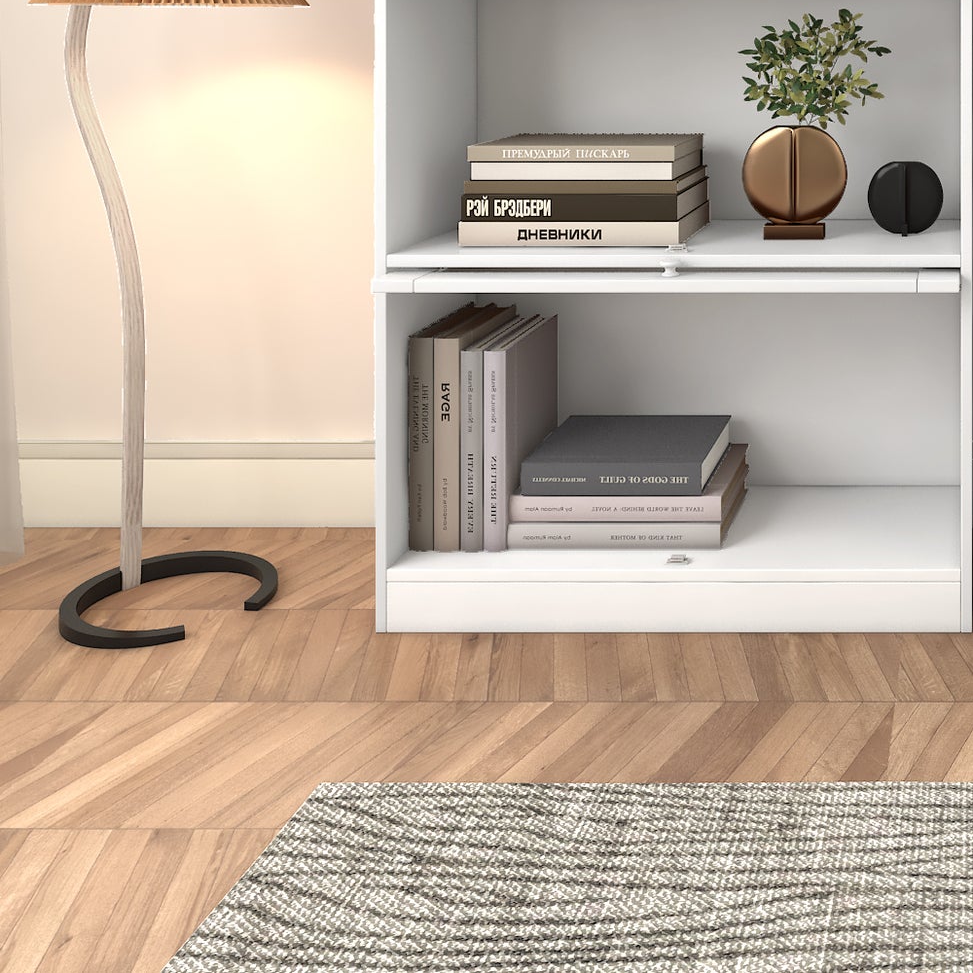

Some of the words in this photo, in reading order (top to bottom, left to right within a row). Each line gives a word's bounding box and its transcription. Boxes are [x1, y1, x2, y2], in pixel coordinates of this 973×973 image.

[502, 148, 571, 159] ПРЕМУДРЫЙ
[576, 149, 630, 158] ПИСКАРЬ
[466, 195, 489, 217] РЭЙ
[494, 199, 552, 218] БРЭДБЕРИ
[517, 229, 602, 241] ДНЕВНИКИ
